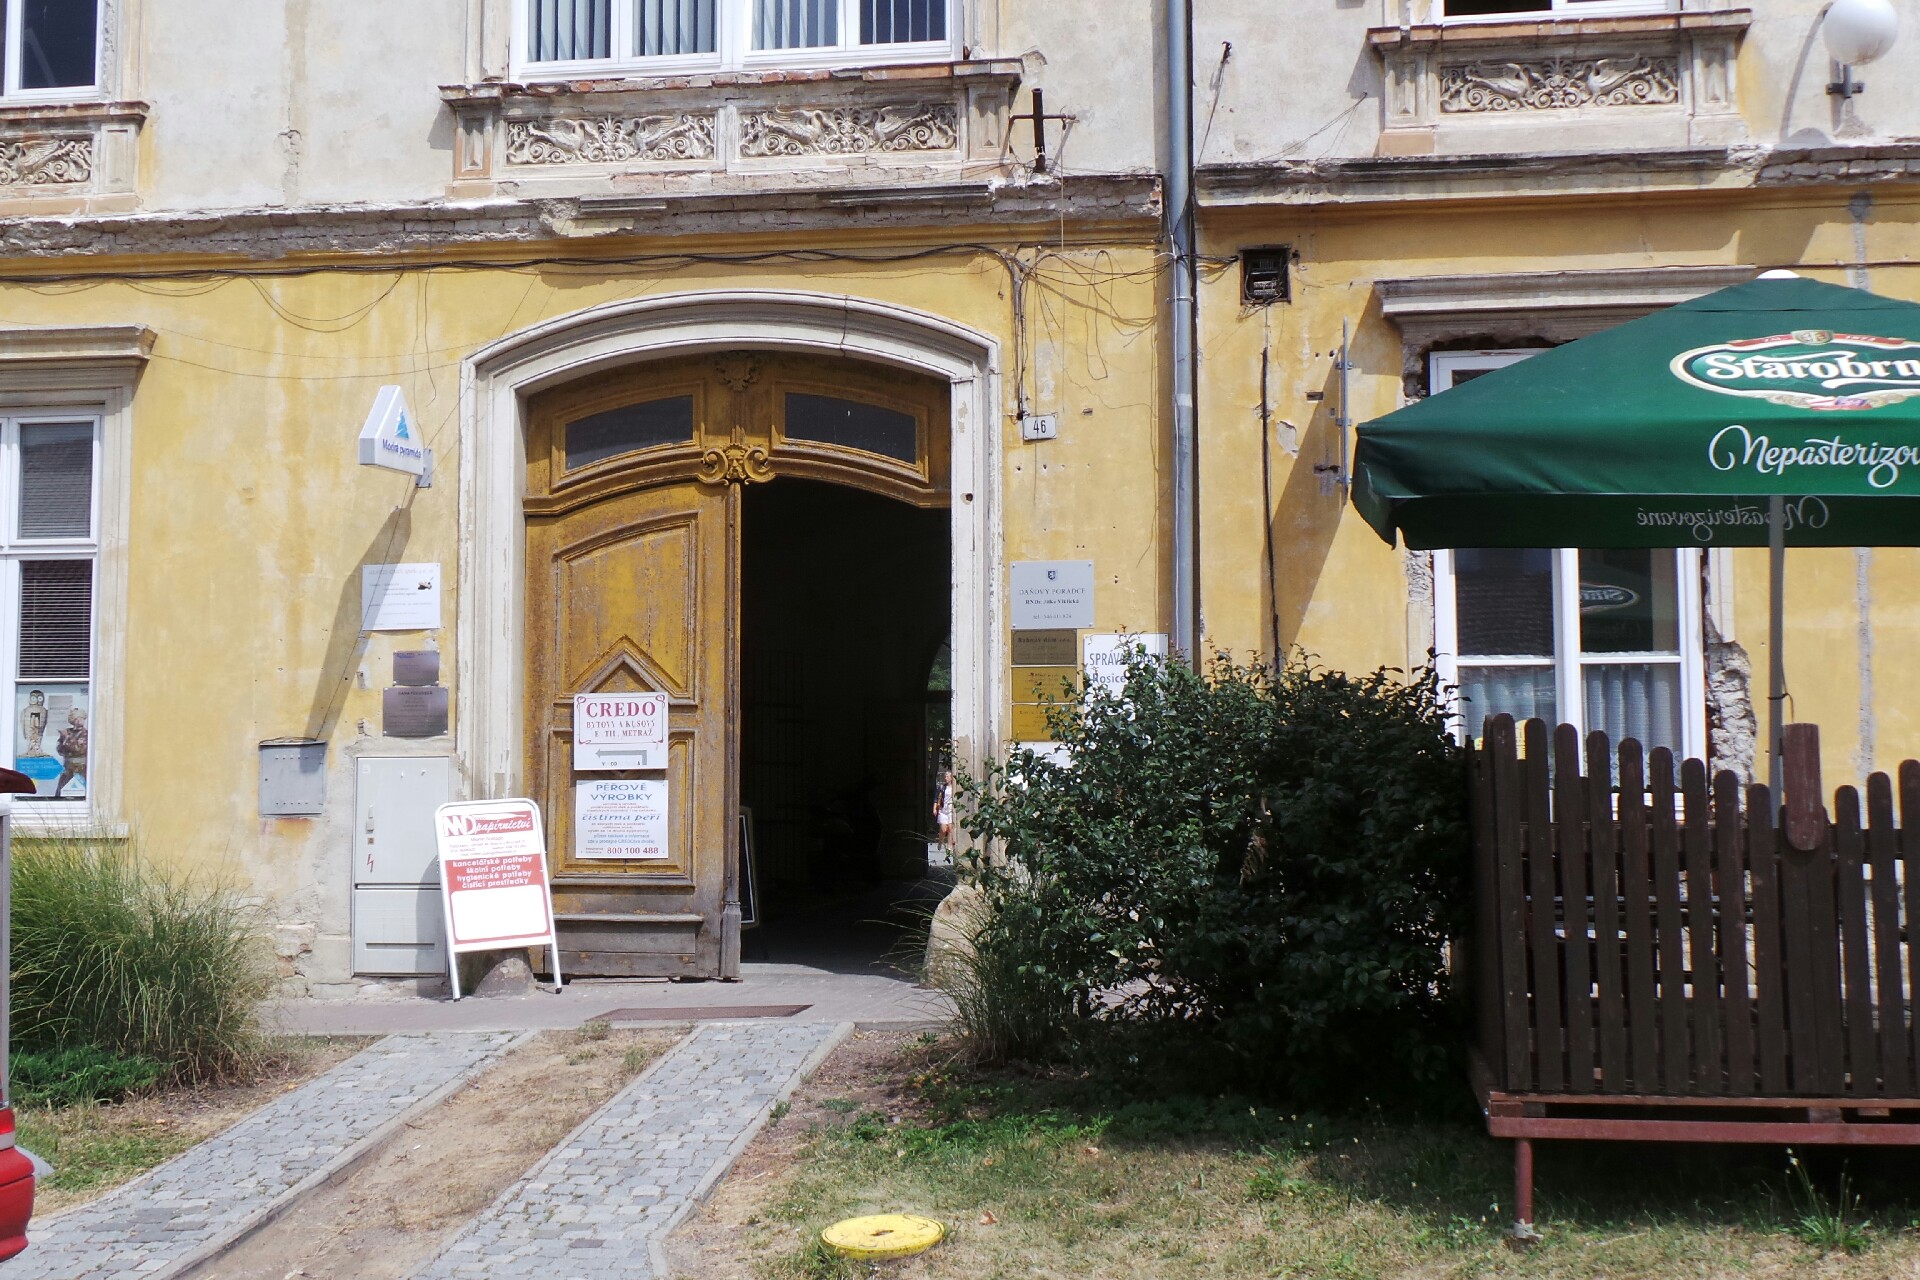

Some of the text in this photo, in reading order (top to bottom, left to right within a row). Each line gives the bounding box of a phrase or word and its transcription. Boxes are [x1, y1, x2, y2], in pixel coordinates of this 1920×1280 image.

[1033, 420, 1046, 433] 46
[1051, 587, 1086, 595] PORADCE
[586, 701, 656, 717] CREDO
[596, 783, 647, 791] PÉŘOVÉ
[591, 792, 653, 801] VÝROBKY
[582, 813, 662, 822] čistírna peří
[475, 817, 531, 834] papírnictví
[607, 847, 622, 855] 800
[642, 846, 659, 854] 488
[452, 856, 533, 867] kancelářské potřeby
[466, 864, 521, 874] školní potřeby
[457, 870, 532, 882] hygienické potřeby
[488, 878, 529, 887] prostředky
